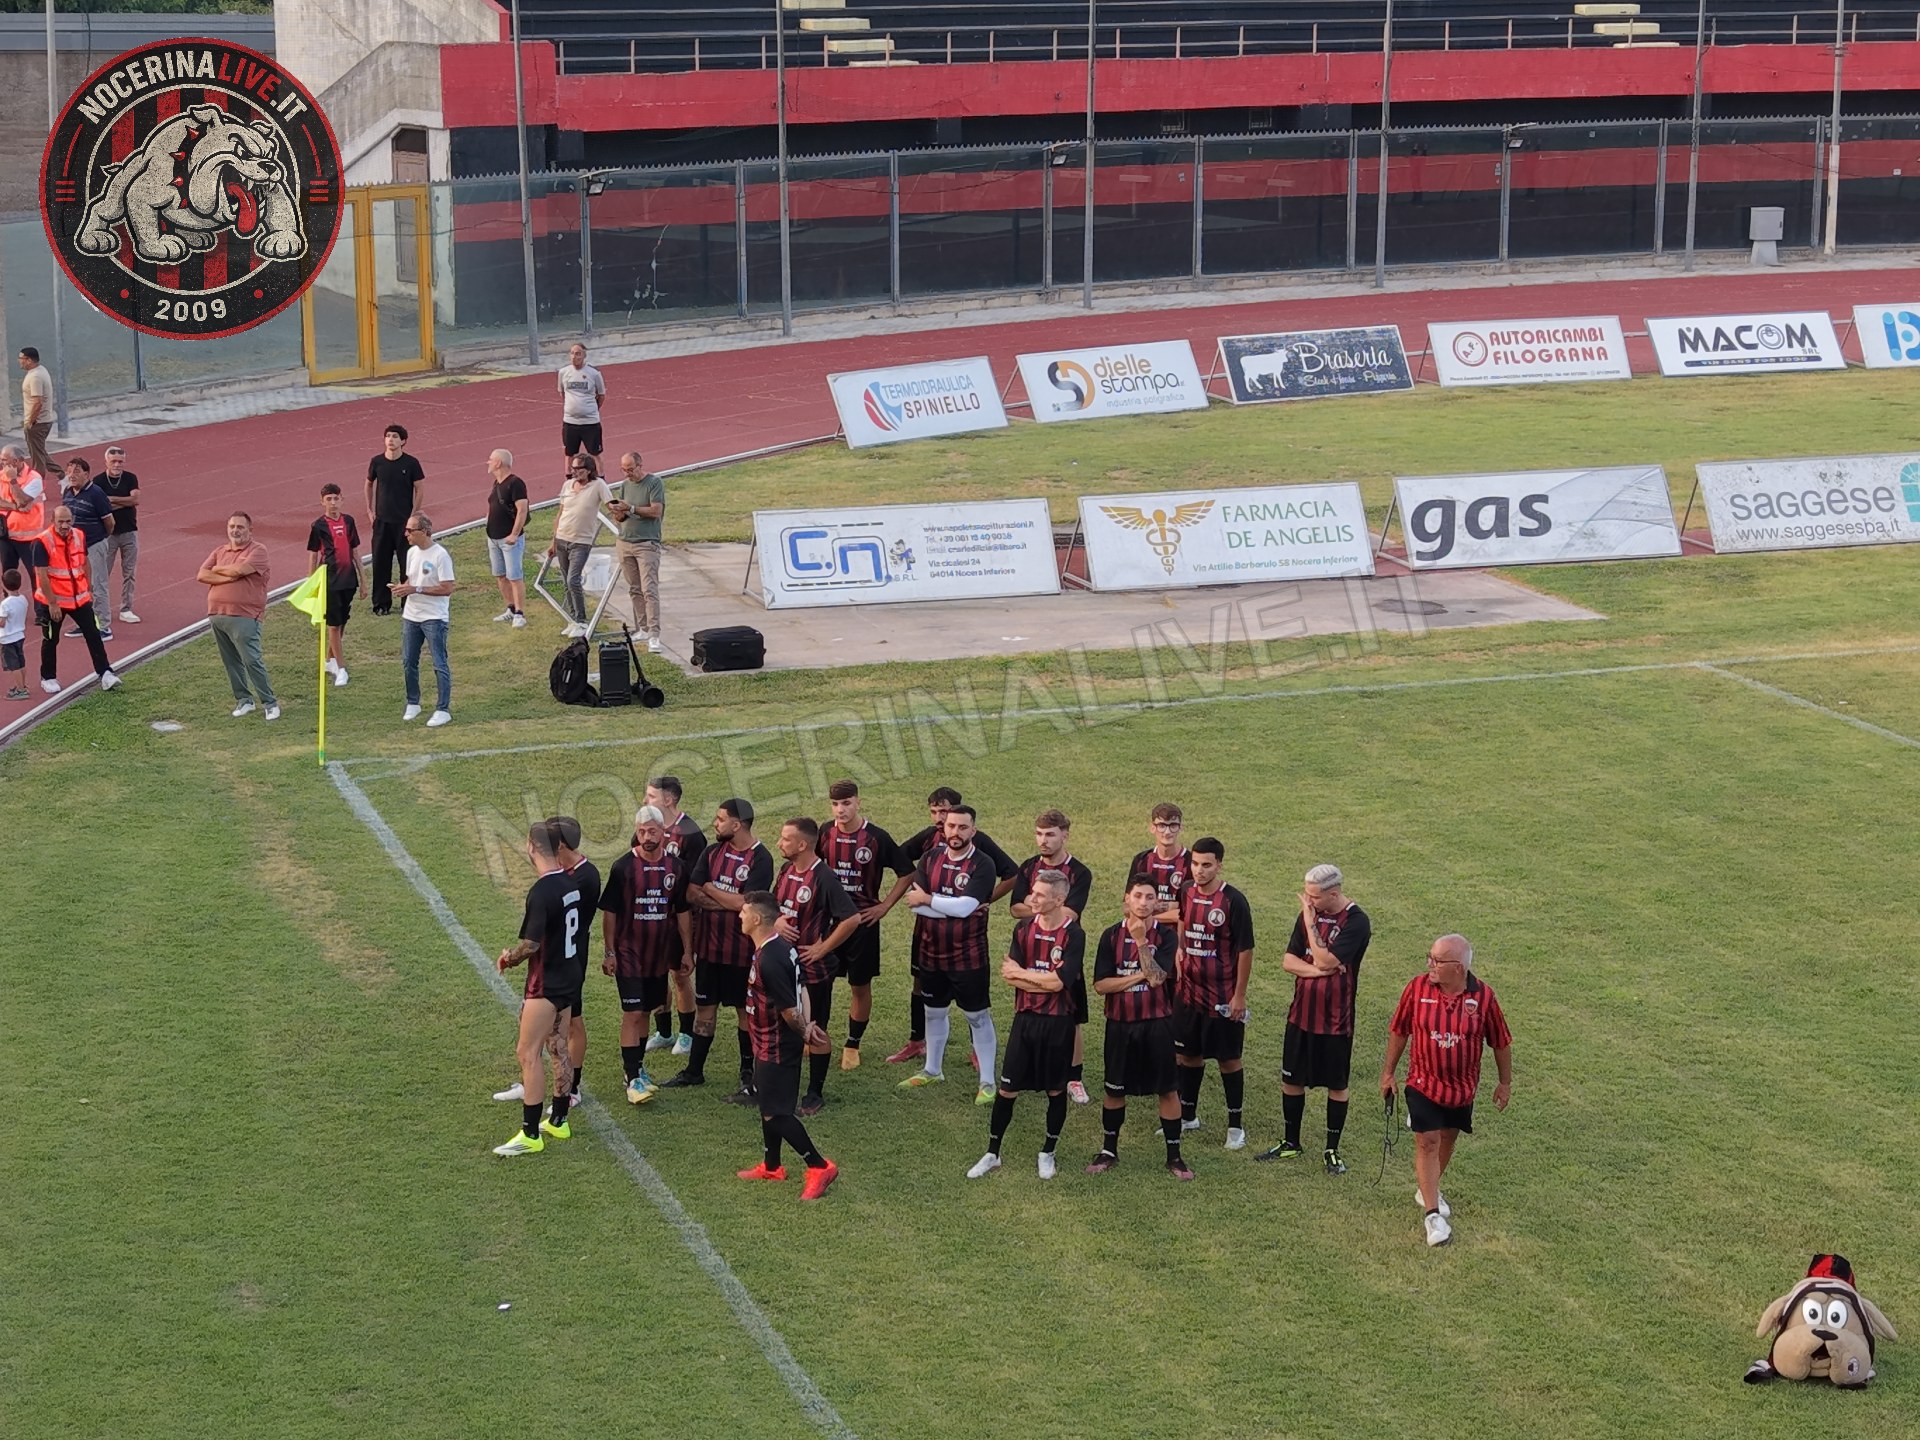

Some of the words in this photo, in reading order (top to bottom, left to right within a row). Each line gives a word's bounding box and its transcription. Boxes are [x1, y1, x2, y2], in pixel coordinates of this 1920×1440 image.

[1489, 327, 1605, 347] AUTORICAMBI
[1678, 322, 1818, 354] MACOM
[1093, 353, 1152, 378] dielle
[1493, 346, 1609, 366] FILOGRANA
[882, 374, 975, 400] TERMOIDRAULICA
[1100, 372, 1180, 395] stampa
[903, 392, 981, 419] SPINIELLO
[1222, 500, 1338, 523] FARMACIA
[1226, 531, 1256, 549] DE
[1263, 524, 1354, 547] ANGELIS
[1410, 493, 1552, 561] gas
[1736, 518, 1902, 541] www.saggesespa.it
[1193, 564, 1207, 573] Via
[1291, 557, 1321, 566] Nocera
[1322, 554, 1359, 565] Inferiore
